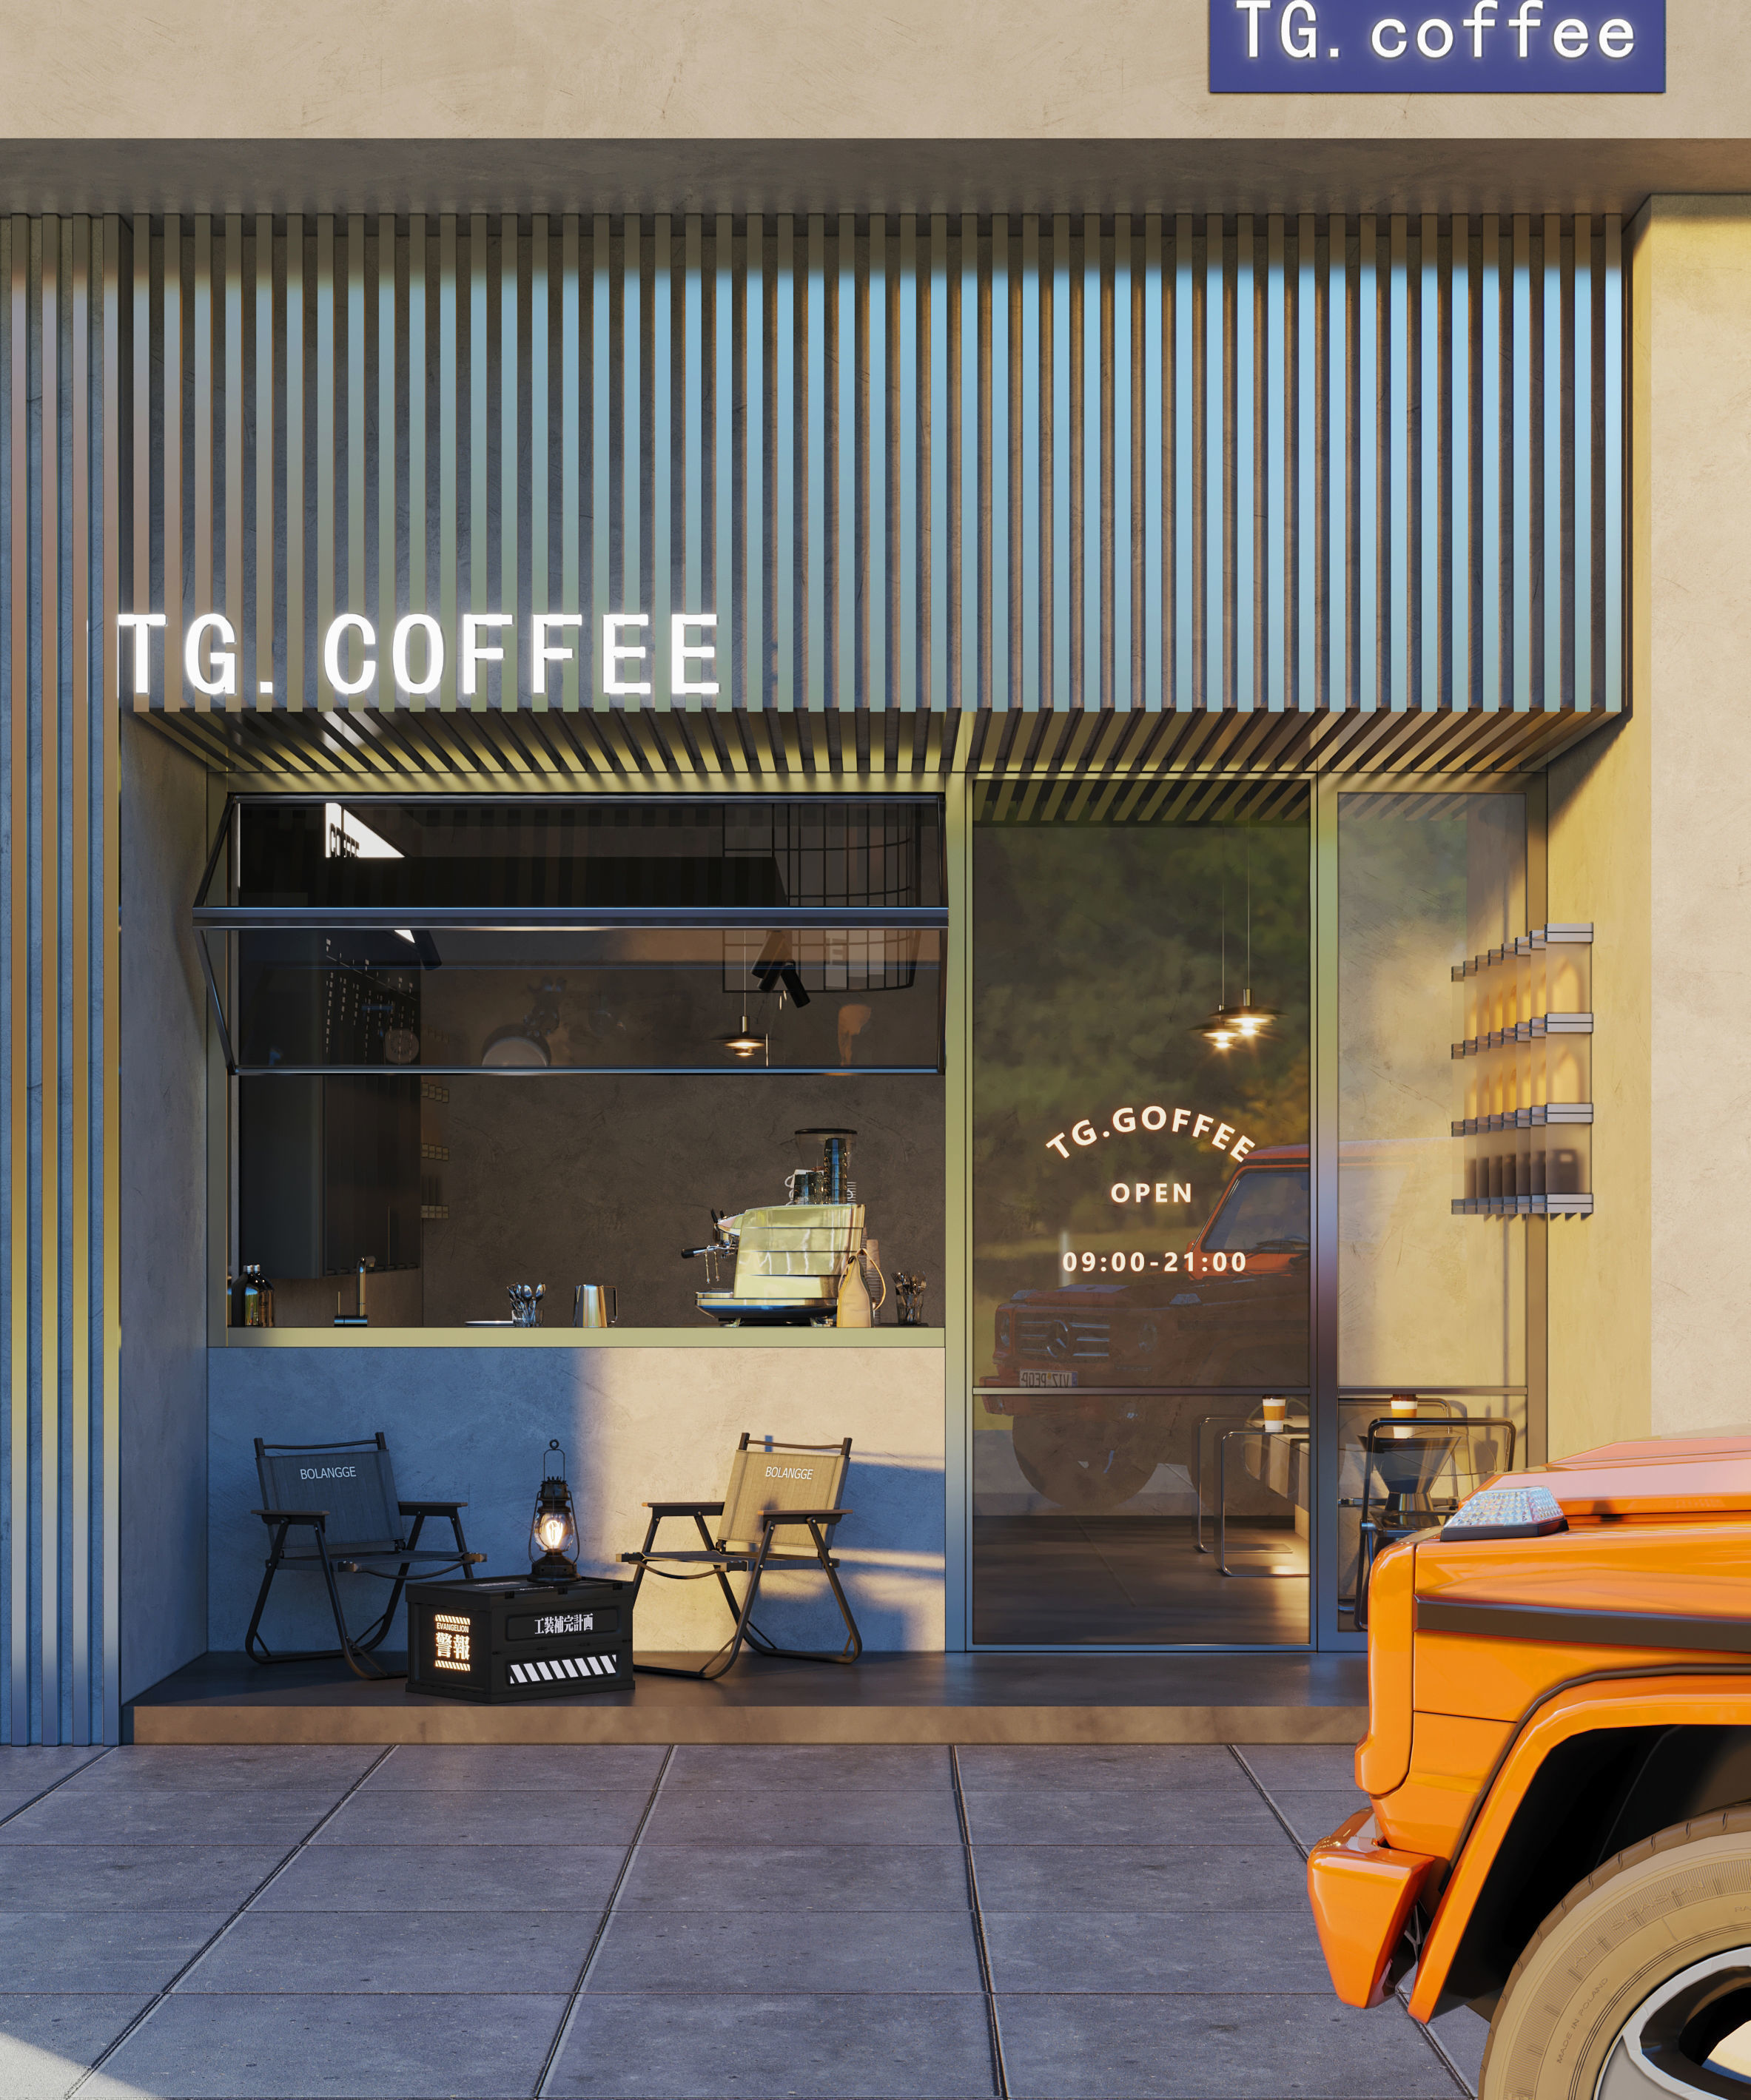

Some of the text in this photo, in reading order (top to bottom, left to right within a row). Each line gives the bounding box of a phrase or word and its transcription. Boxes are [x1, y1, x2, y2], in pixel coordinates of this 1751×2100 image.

[1236, 0, 1634, 58] TG. coffee
[117, 613, 720, 696] TG. COFFEE
[1046, 1105, 1255, 1162] TG.GOFFEE
[1111, 1182, 1191, 1203] OPEN
[1062, 1251, 1246, 1272] 09:00-21:00
[300, 1466, 357, 1480] BOLANGGE
[765, 1466, 814, 1480] BOLANGGE
[437, 1622, 469, 1633] EVANGELION
[435, 1632, 471, 1660] 警報
[1556, 1977, 1608, 2064] MADE IN POLAND
